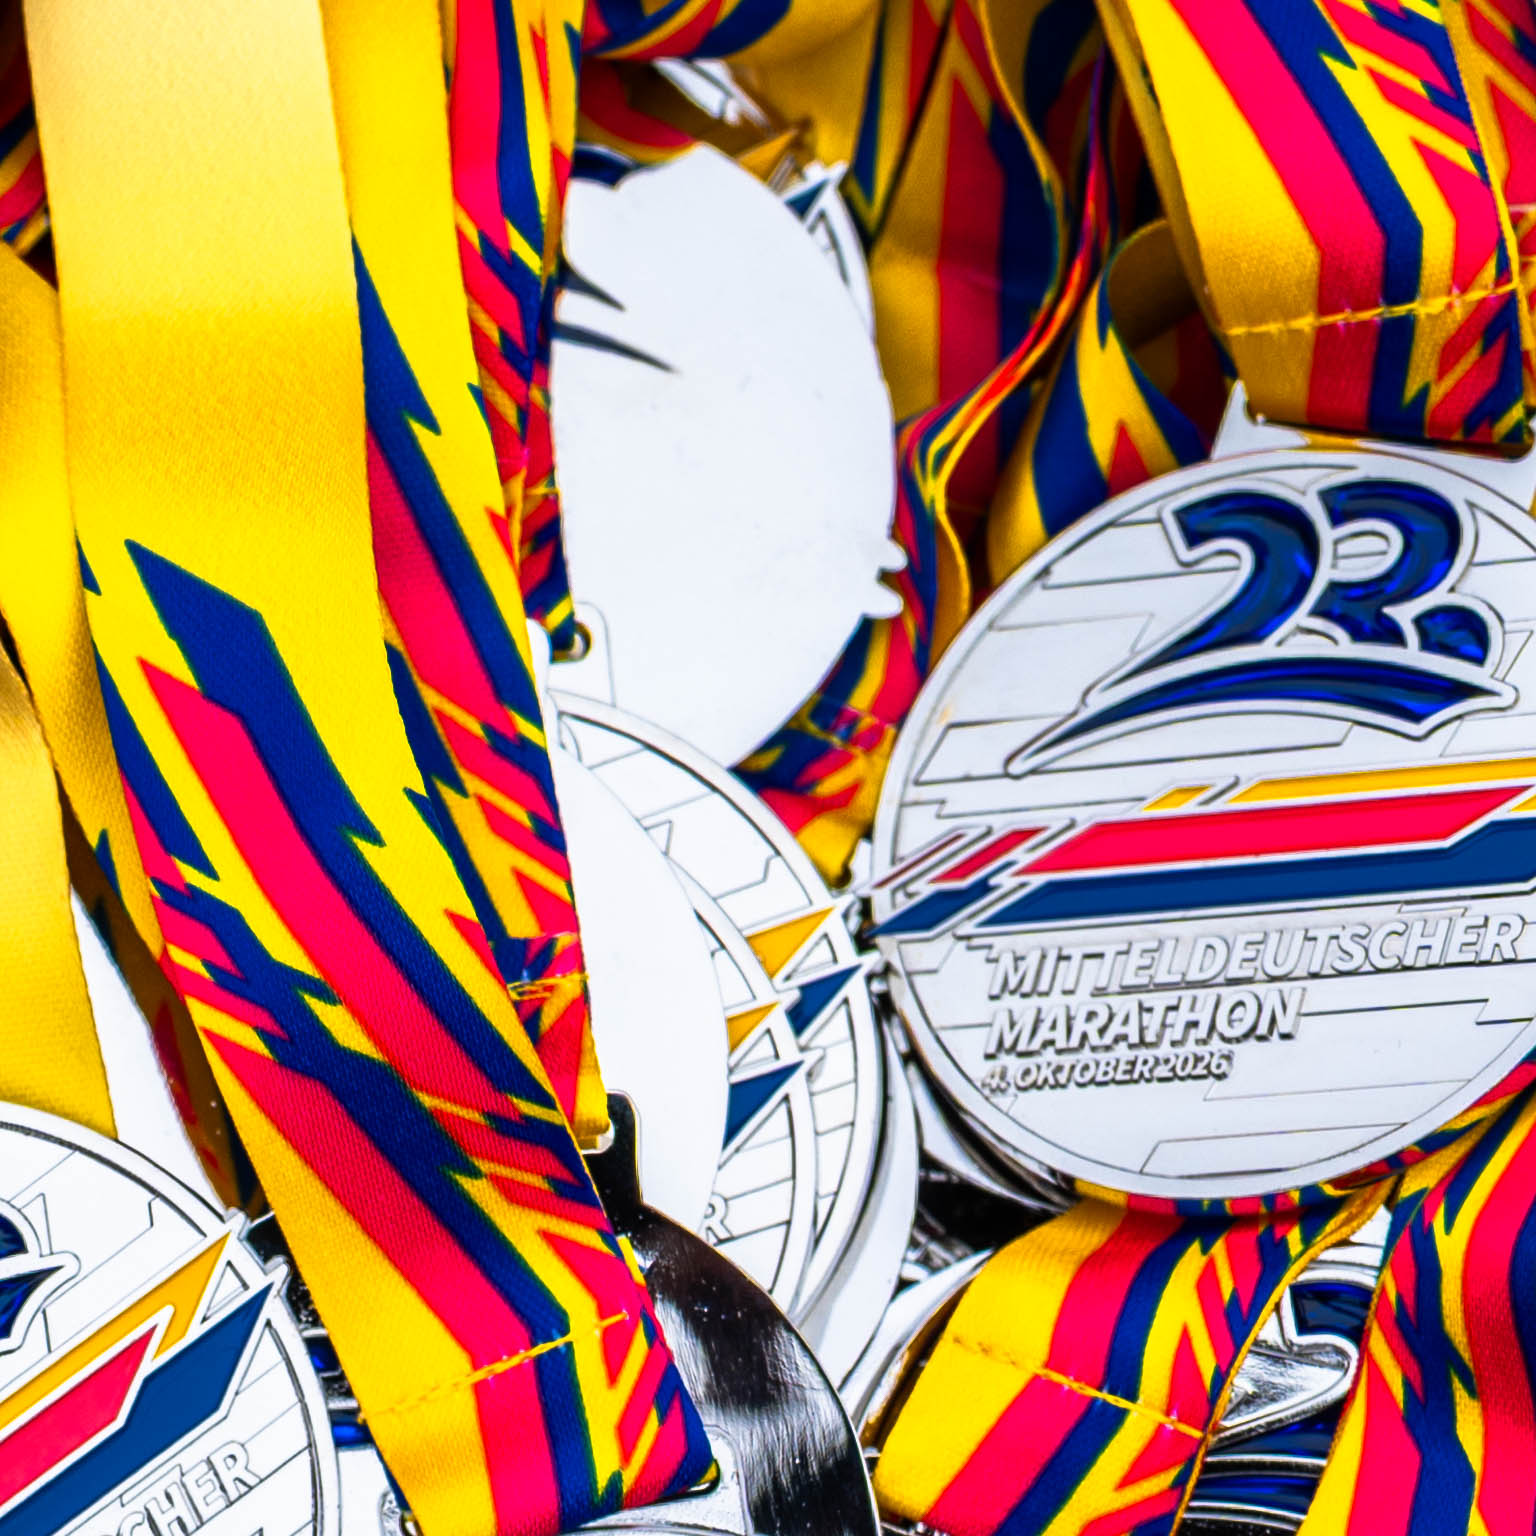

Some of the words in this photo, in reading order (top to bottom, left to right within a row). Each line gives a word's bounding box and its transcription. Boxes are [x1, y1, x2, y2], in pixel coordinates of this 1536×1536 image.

[989, 914, 1527, 997] MITTELDEUTSCHER
[984, 987, 1306, 1060] MARATHON
[1015, 1055, 1156, 1092] OKTOBER
[1157, 1049, 1236, 1081] 2026
